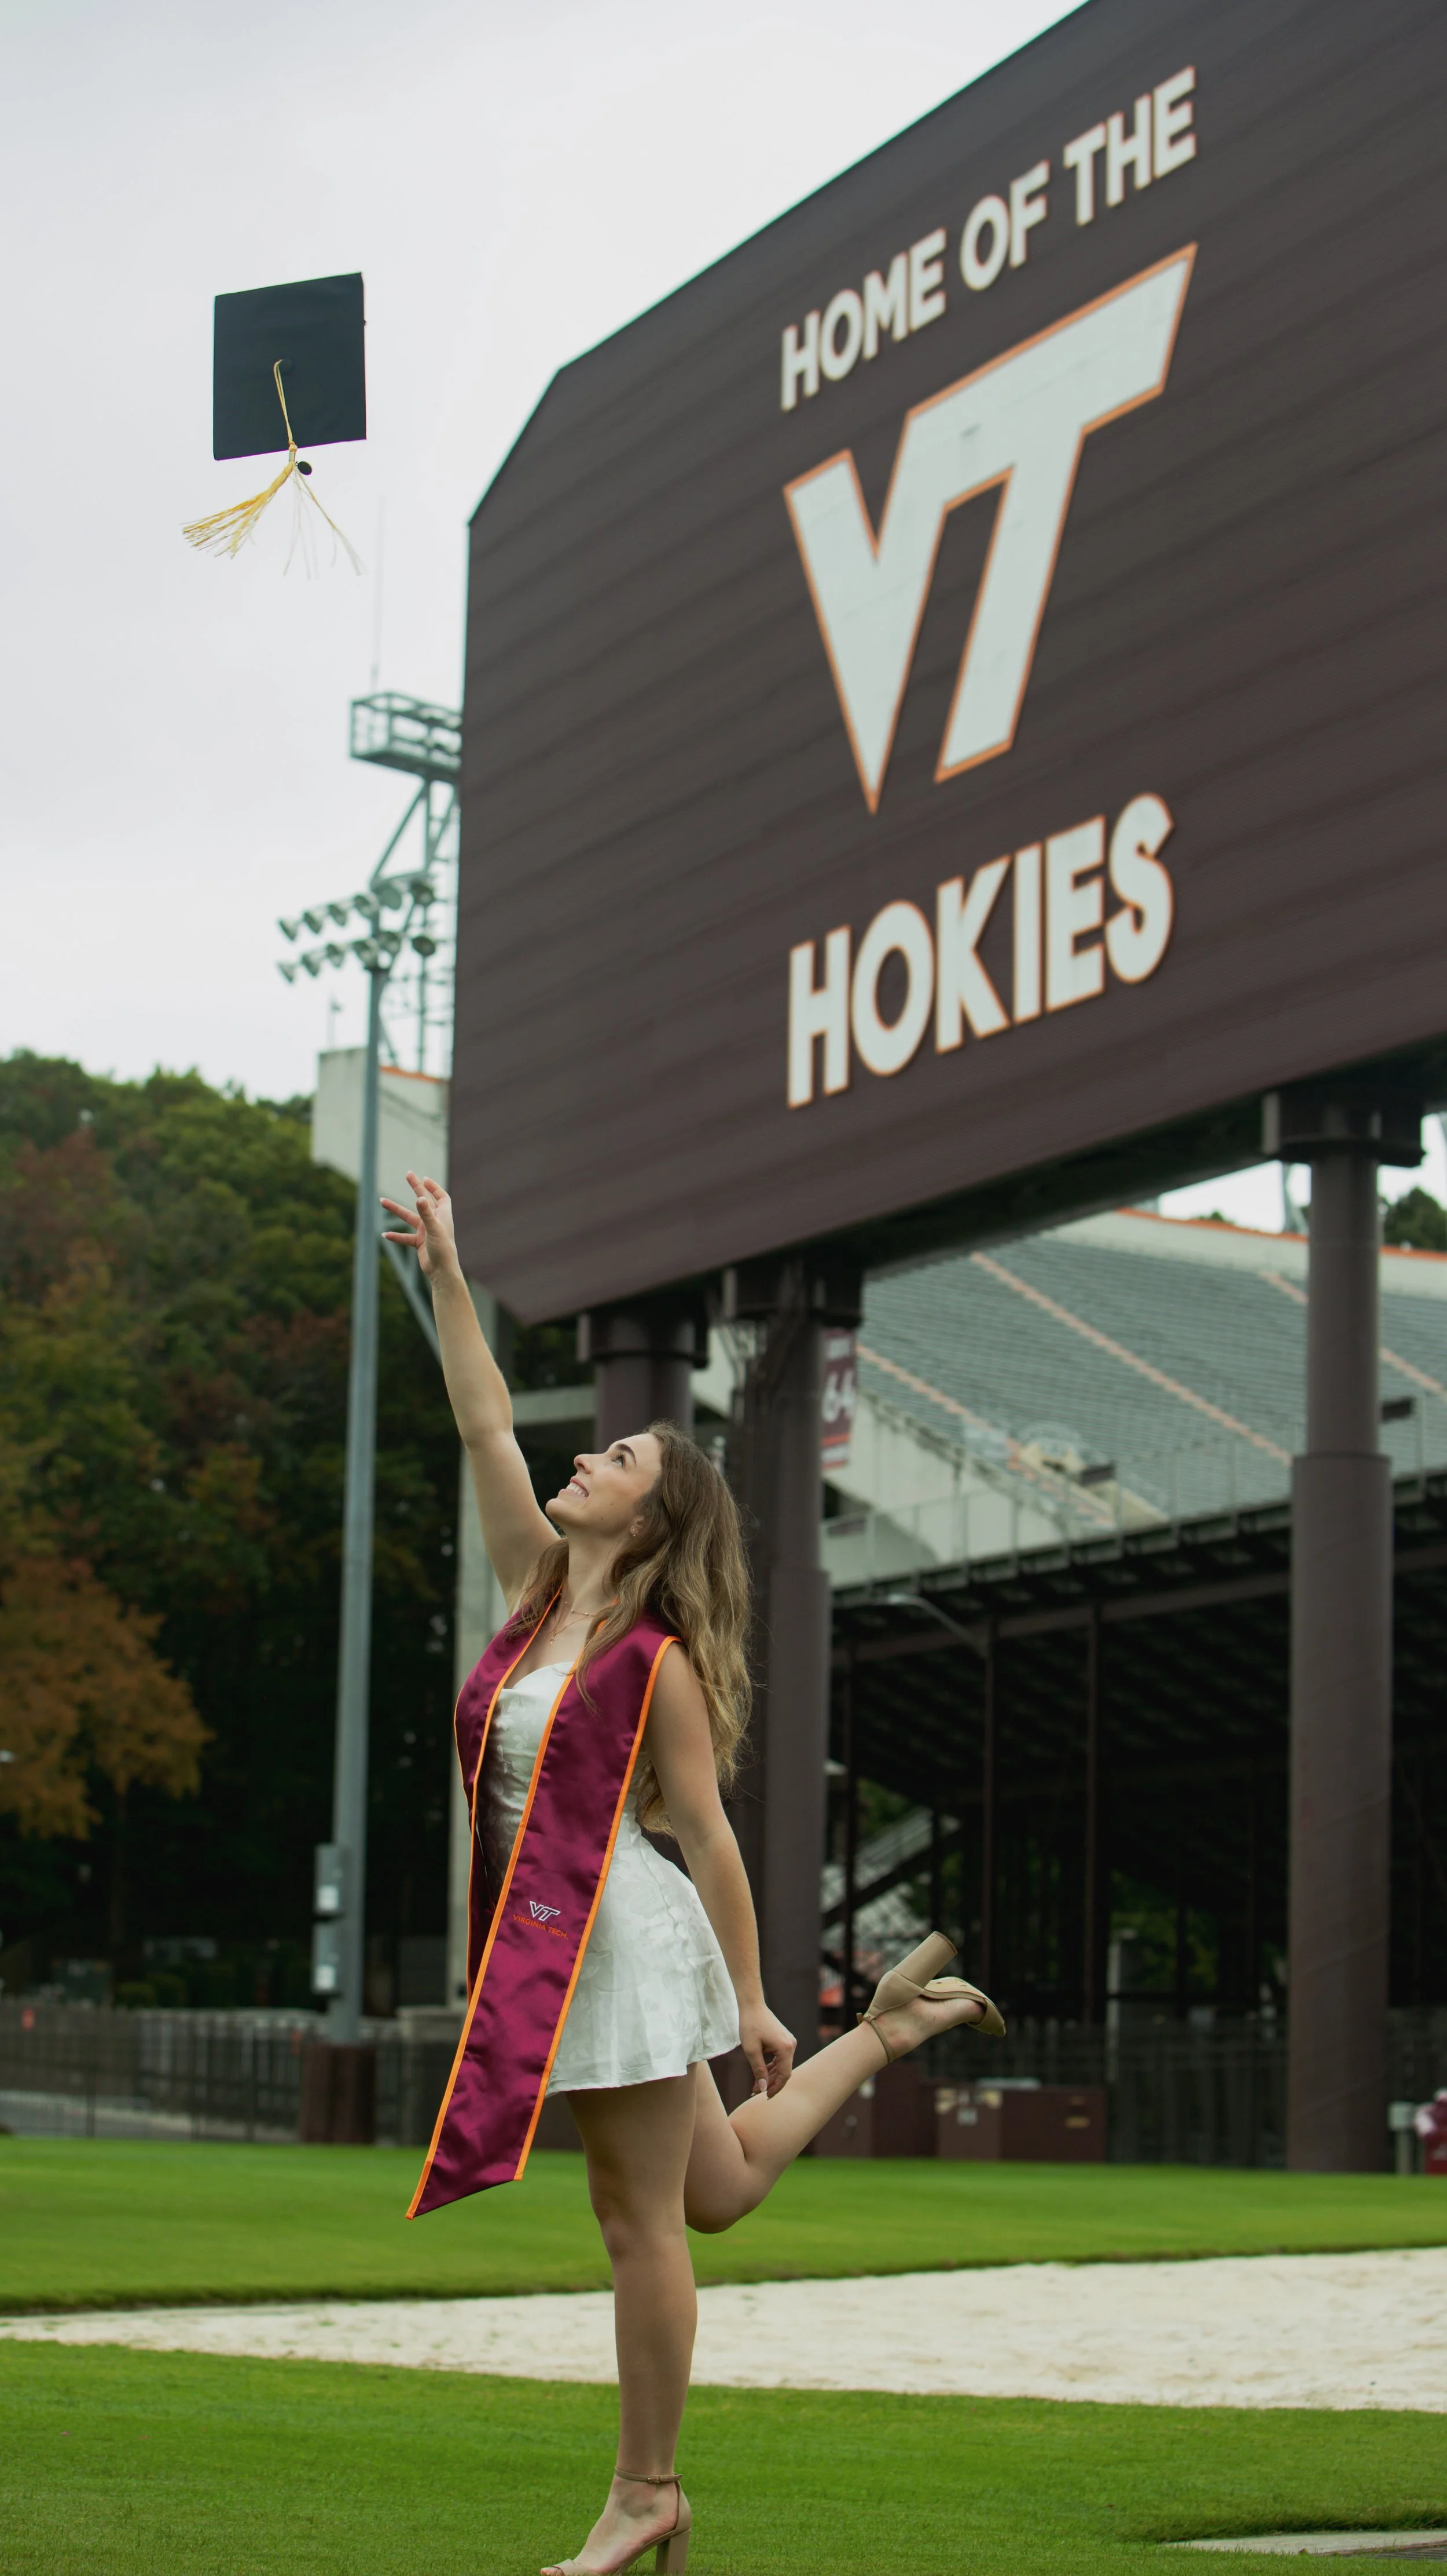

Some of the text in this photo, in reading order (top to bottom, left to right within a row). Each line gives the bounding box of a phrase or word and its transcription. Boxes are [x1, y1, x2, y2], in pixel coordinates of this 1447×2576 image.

[781, 65, 1196, 411] HOME OF THE
[784, 241, 1198, 814] VT
[787, 792, 1175, 1109] HOKIES
[513, 1914, 546, 1930] VIRGINIA
[529, 1900, 561, 1921] VT
